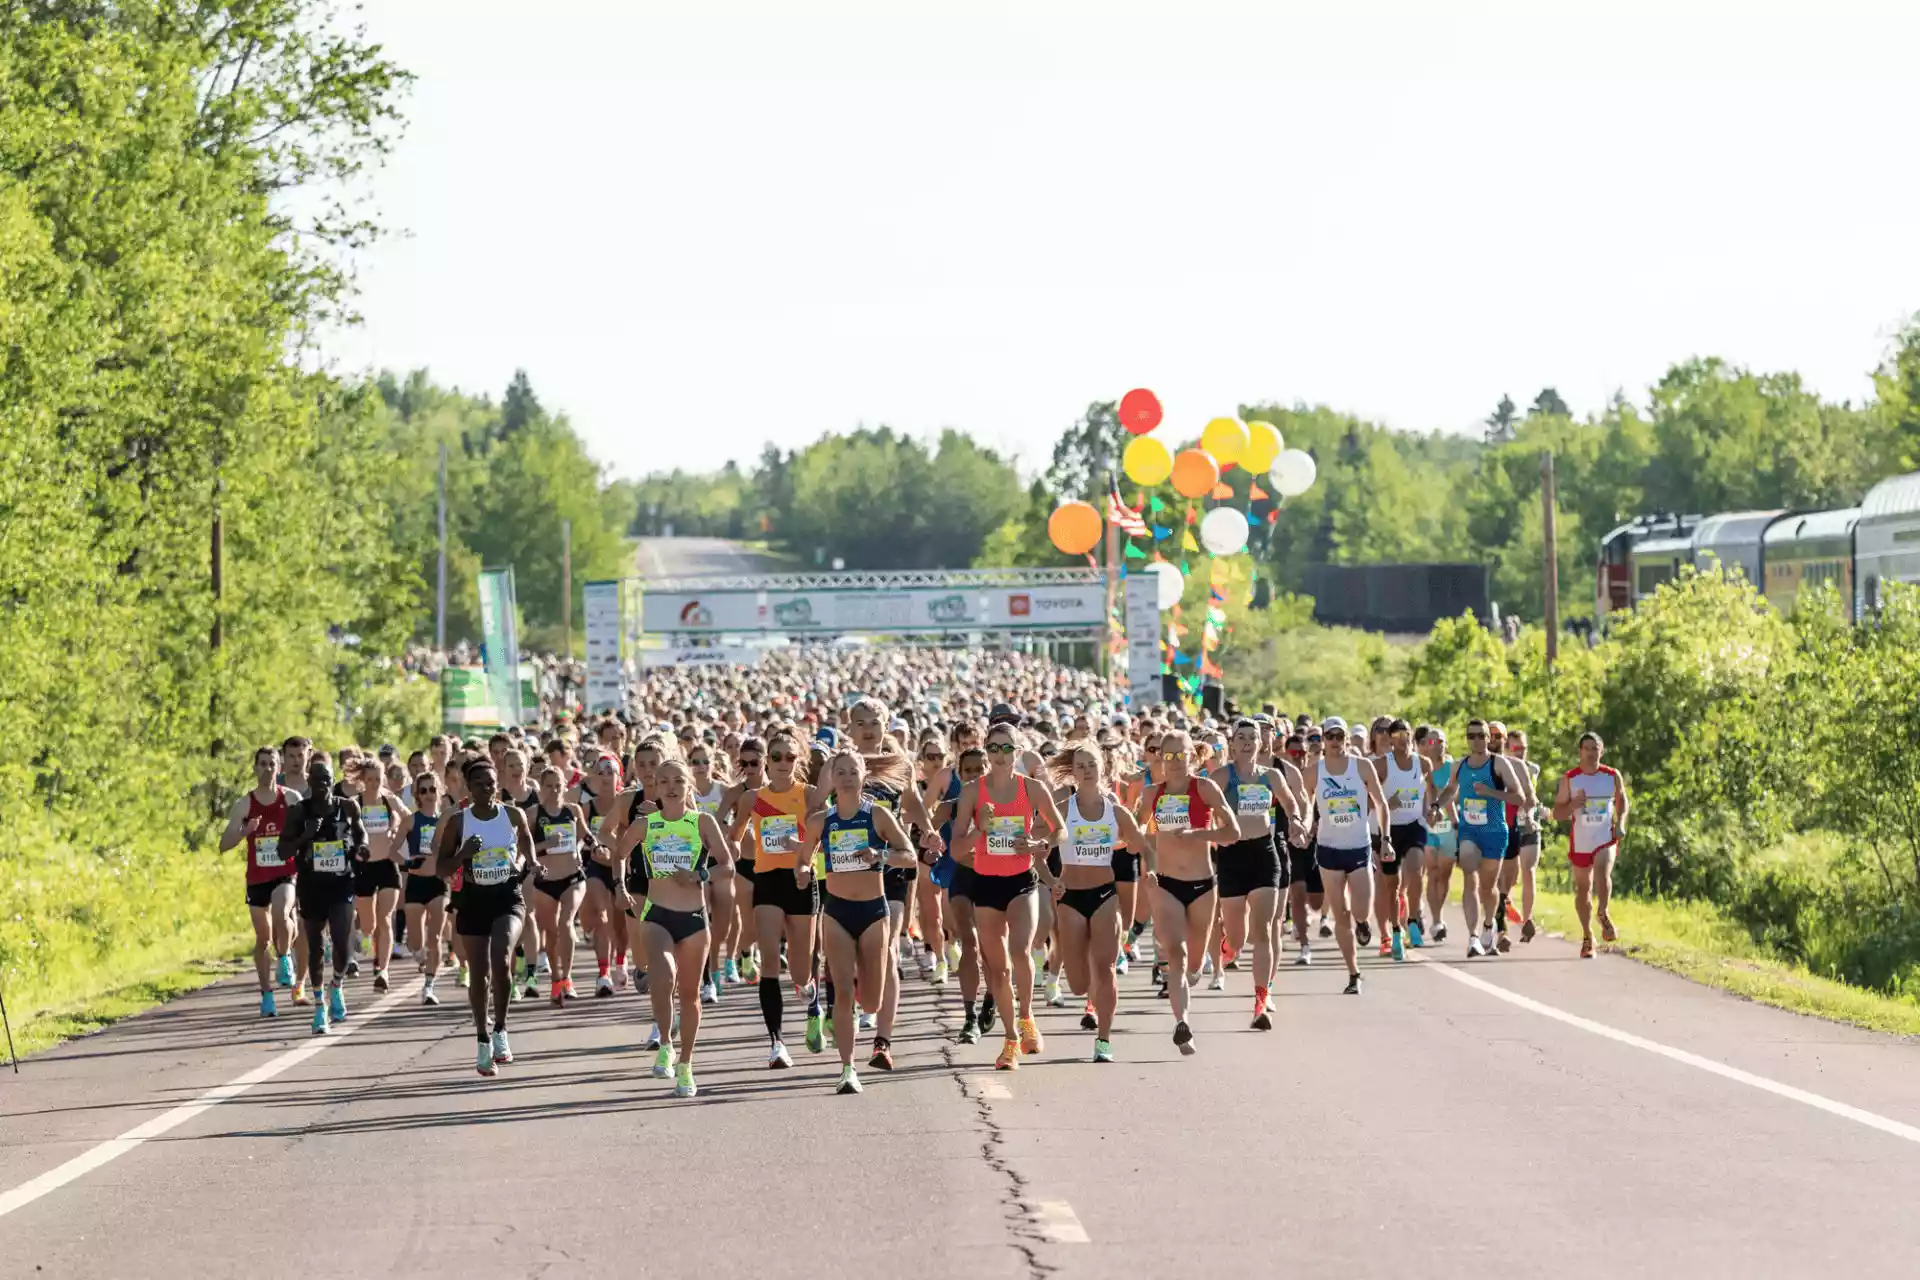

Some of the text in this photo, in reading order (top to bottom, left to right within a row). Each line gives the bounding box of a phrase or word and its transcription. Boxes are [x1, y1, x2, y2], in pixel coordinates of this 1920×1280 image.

[1035, 600, 1085, 609] TOYOTA
[1156, 813, 1190, 825] Sullivan
[765, 836, 783, 848] Cul
[989, 836, 1015, 848] Selle
[1075, 845, 1111, 858] Vaughn
[319, 858, 340, 868] 4427
[652, 852, 691, 865] Lindwurm
